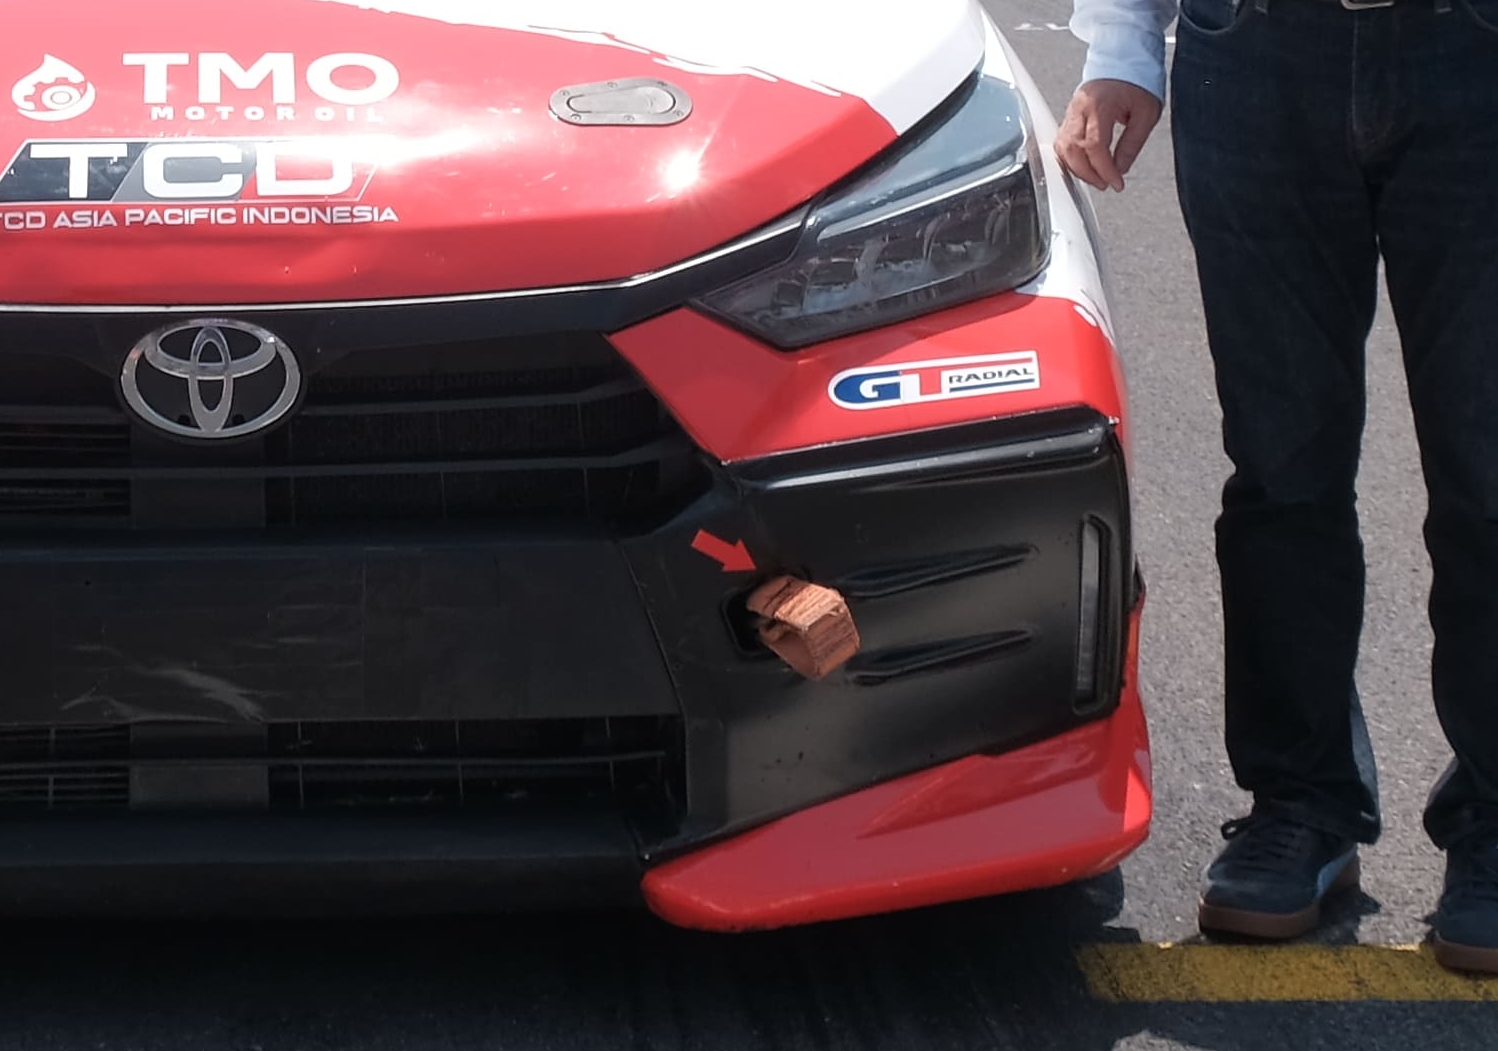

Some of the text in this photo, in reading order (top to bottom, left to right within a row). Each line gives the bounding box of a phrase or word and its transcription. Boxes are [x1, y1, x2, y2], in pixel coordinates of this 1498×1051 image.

[122, 52, 400, 105] TMO
[151, 105, 384, 125] MOTOR OIL
[29, 141, 354, 199] TCD
[53, 209, 118, 229] ASIA
[124, 207, 237, 226] PACIFIC
[242, 205, 399, 225] INDONESIA
[834, 366, 1035, 404] GT RADIAL
